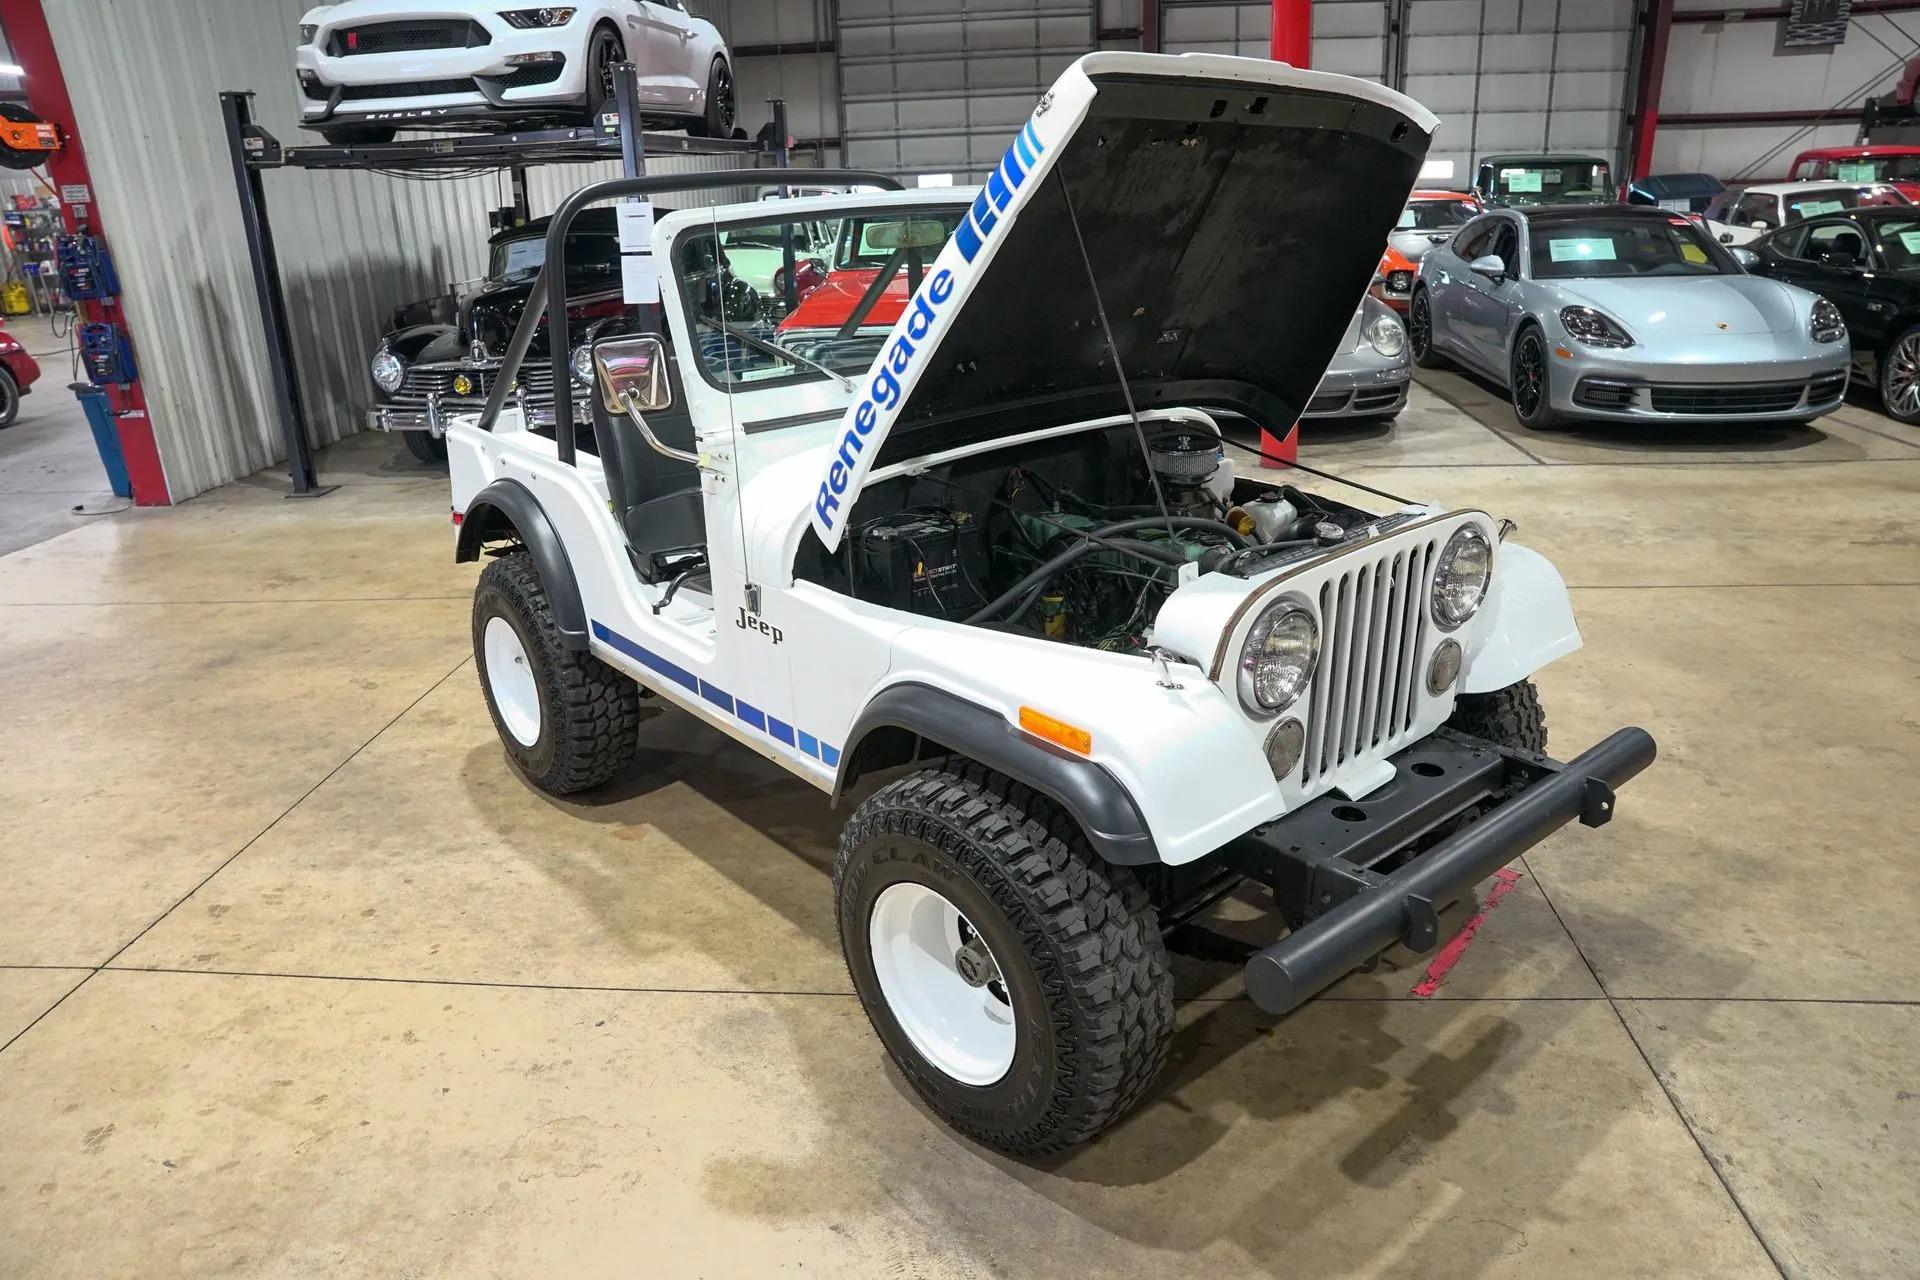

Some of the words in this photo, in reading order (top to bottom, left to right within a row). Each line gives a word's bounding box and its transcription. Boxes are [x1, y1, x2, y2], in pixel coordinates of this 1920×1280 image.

[366, 110, 447, 119] SHELBY
[815, 266, 955, 530] Renegade
[736, 606, 783, 645] Jeep
[871, 845, 956, 882] CLAW
